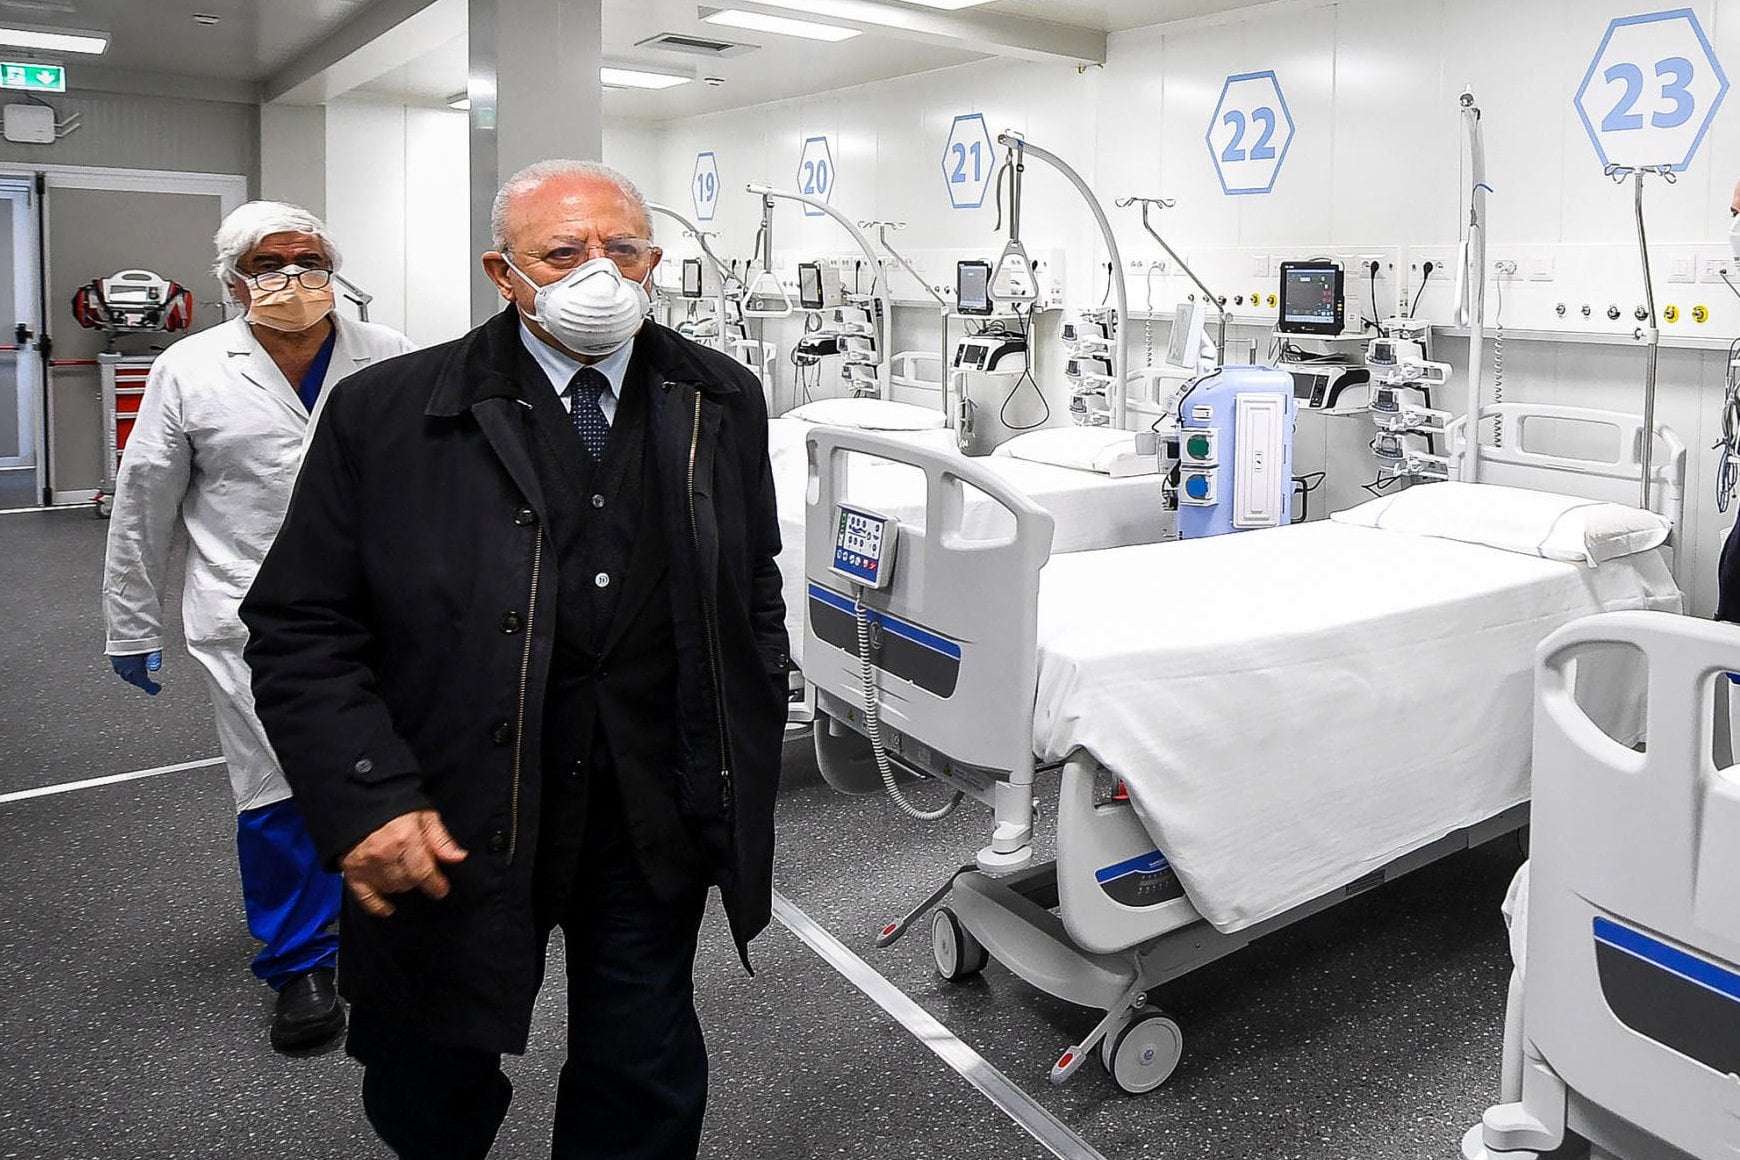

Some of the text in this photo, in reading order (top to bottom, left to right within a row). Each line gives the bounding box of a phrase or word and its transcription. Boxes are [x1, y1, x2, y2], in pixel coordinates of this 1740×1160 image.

[1601, 57, 1695, 132] 23
[1222, 106, 1276, 162] 22
[803, 160, 828, 194] 20
[951, 141, 983, 183] 21
[697, 172, 715, 203] 19
